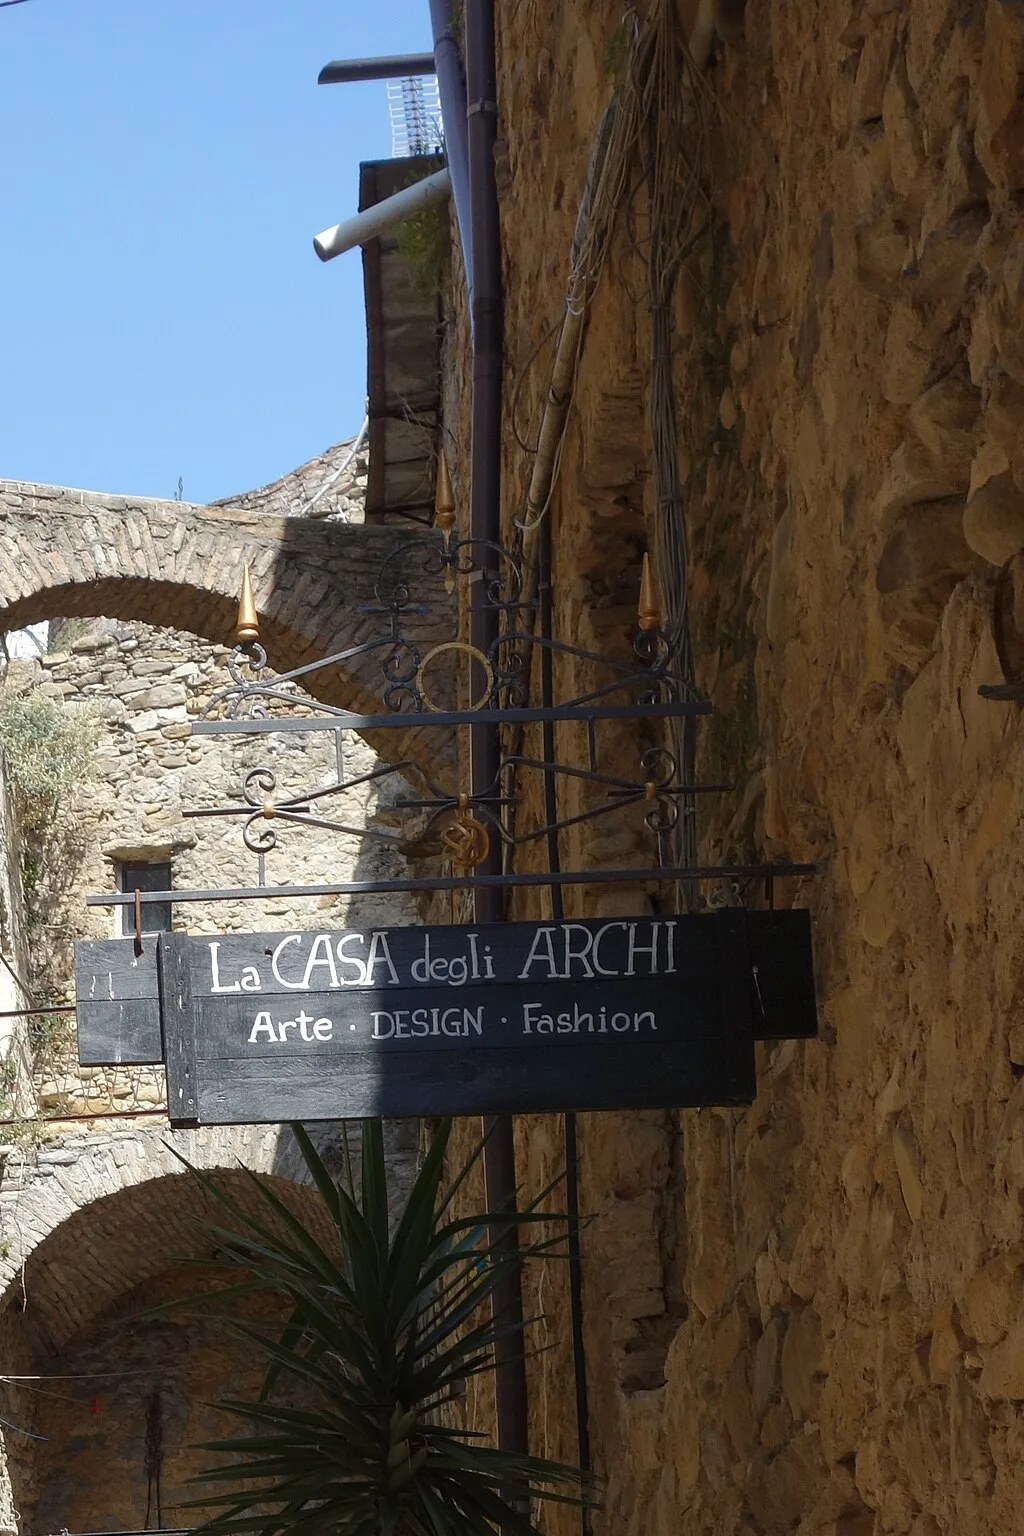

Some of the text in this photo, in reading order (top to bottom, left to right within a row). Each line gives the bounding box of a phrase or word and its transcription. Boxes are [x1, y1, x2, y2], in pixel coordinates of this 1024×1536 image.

[207, 921, 678, 993] La CASA degli ARCHI
[247, 1001, 658, 1043] Arte DESIGN Fashion
